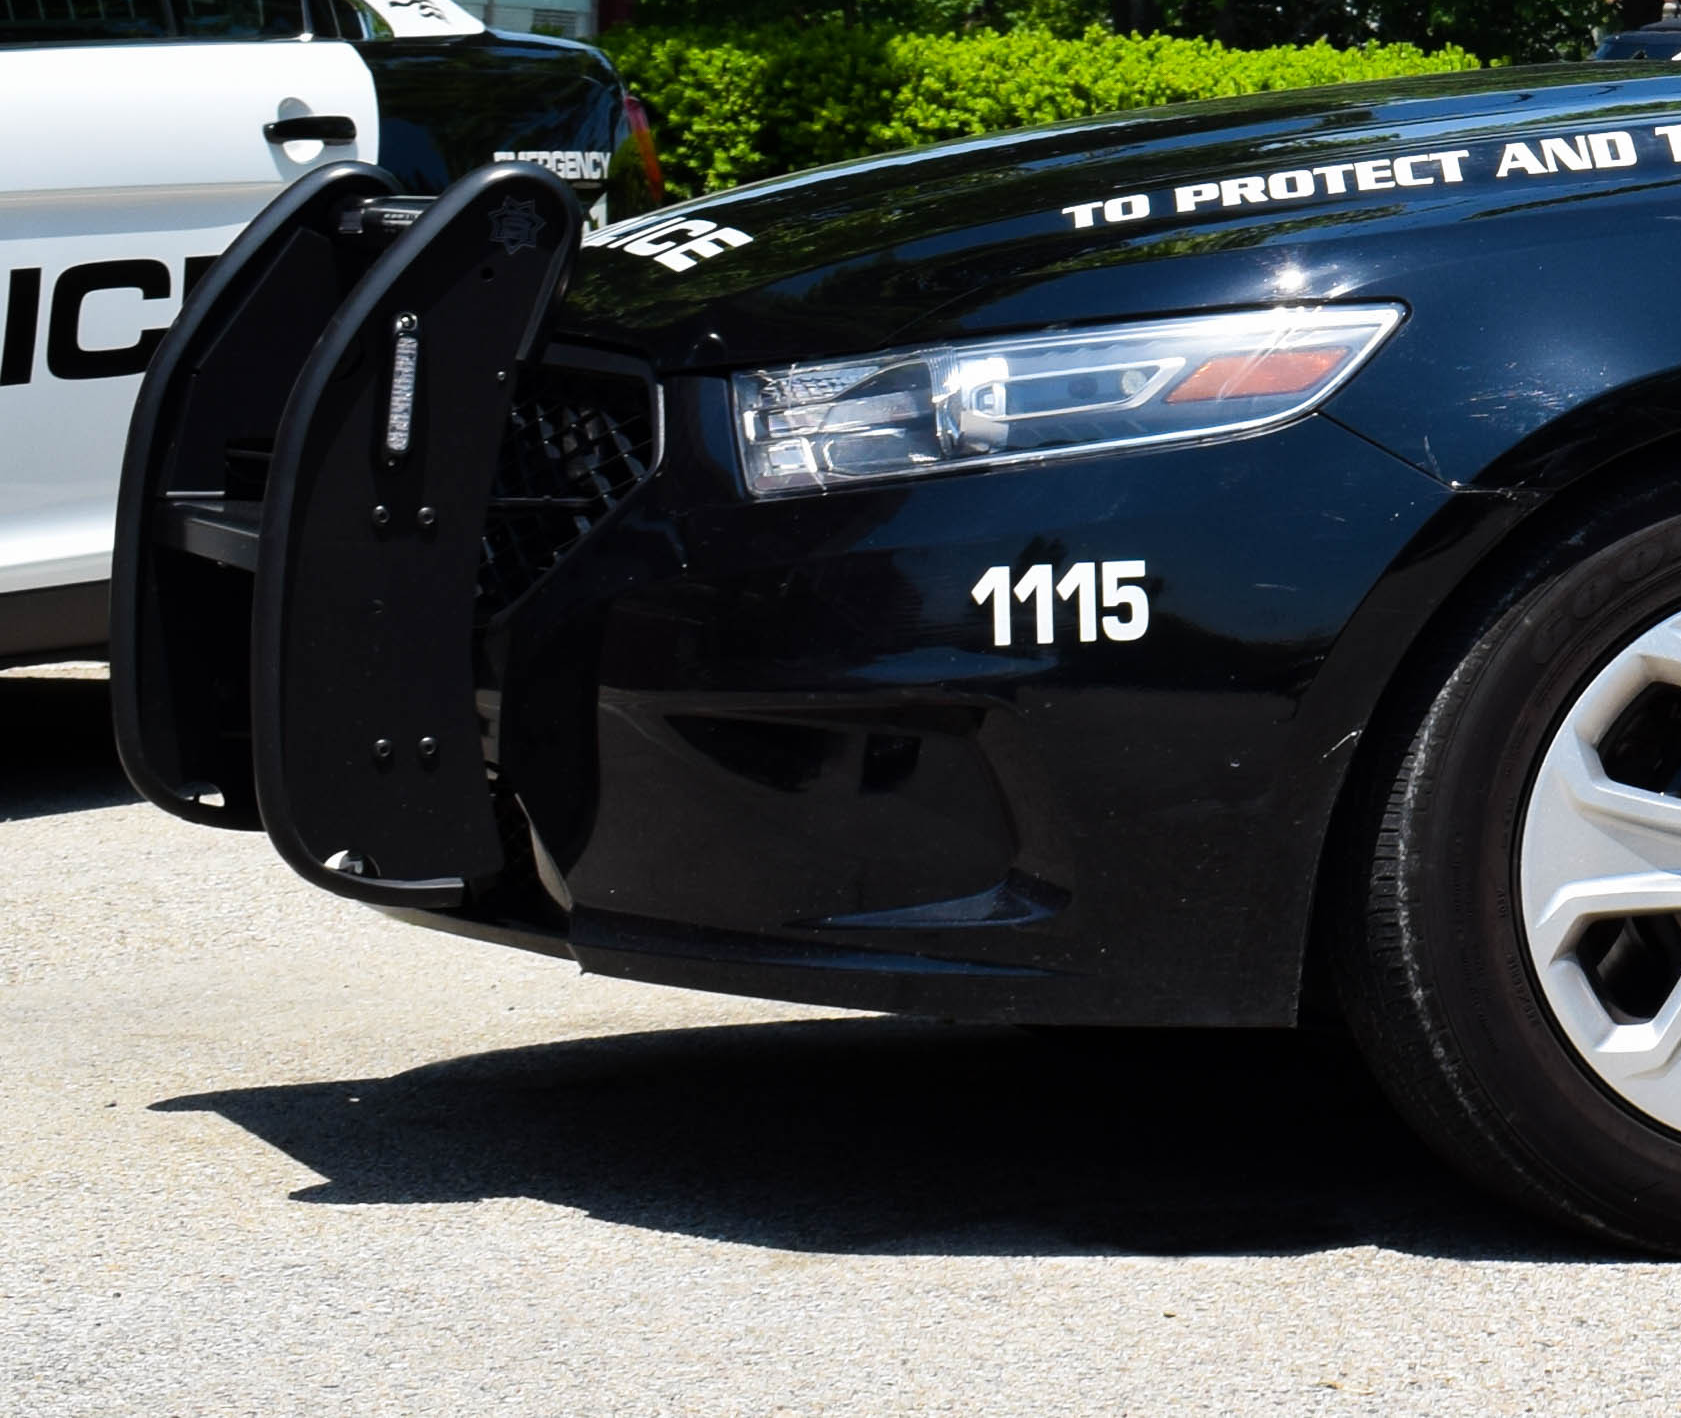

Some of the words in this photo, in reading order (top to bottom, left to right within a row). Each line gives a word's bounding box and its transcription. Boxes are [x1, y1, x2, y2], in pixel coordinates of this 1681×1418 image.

[1062, 195, 1151, 229] TO
[1175, 149, 1469, 213] PROTECT
[1496, 131, 1638, 178] AND
[971, 560, 1149, 646] 1115
